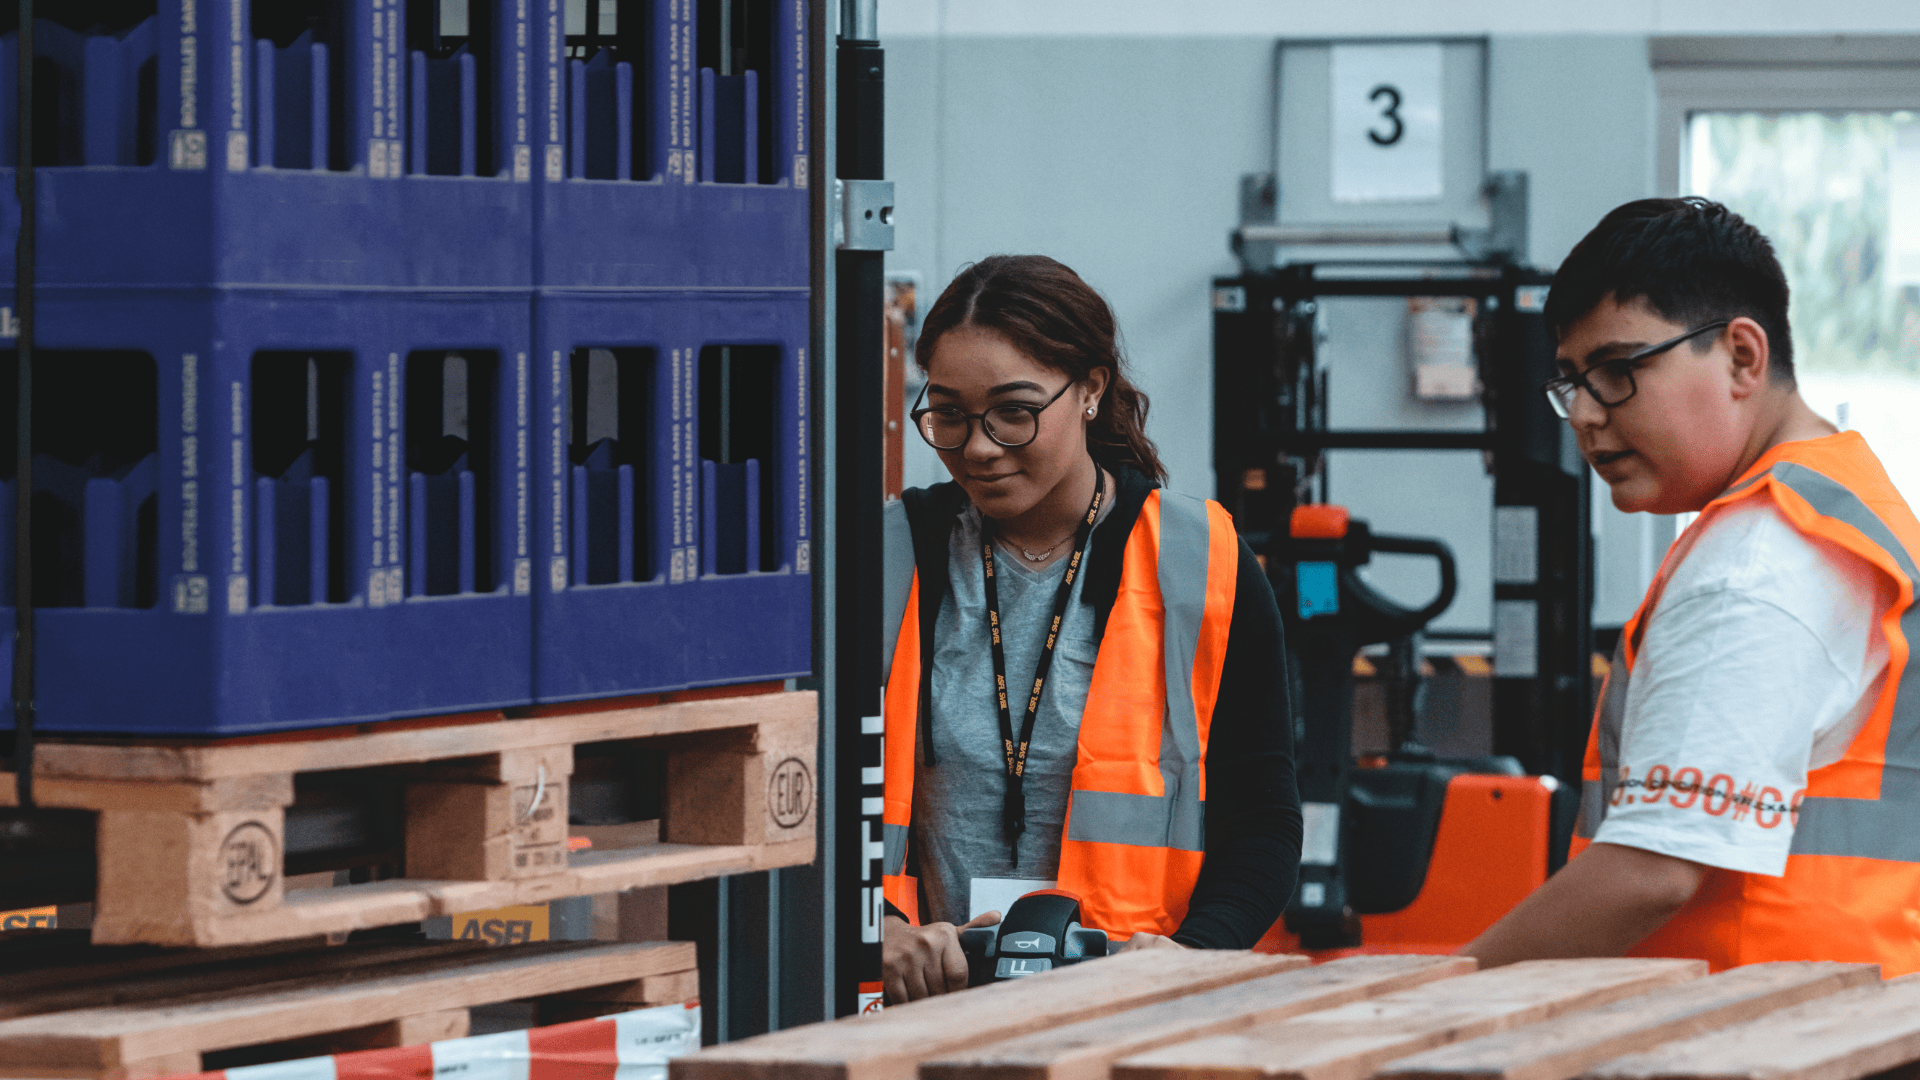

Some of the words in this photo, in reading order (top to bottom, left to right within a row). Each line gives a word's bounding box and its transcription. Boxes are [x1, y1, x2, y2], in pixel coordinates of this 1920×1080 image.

[1365, 83, 1405, 147] 3
[798, 419, 806, 456] SANS
[1065, 568, 1076, 585] ASFL
[989, 609, 998, 627] ASFL
[991, 627, 1000, 645] SVBL
[1046, 633, 1056, 650] ASFL
[997, 674, 1006, 691] ASFL
[1028, 695, 1038, 713] ASFL
[1005, 739, 1014, 756] ASFL
[1018, 741, 1028, 759] SVBL
[1015, 759, 1024, 777] ASFL
[777, 770, 804, 816] EUR
[860, 686, 884, 943] STILL
